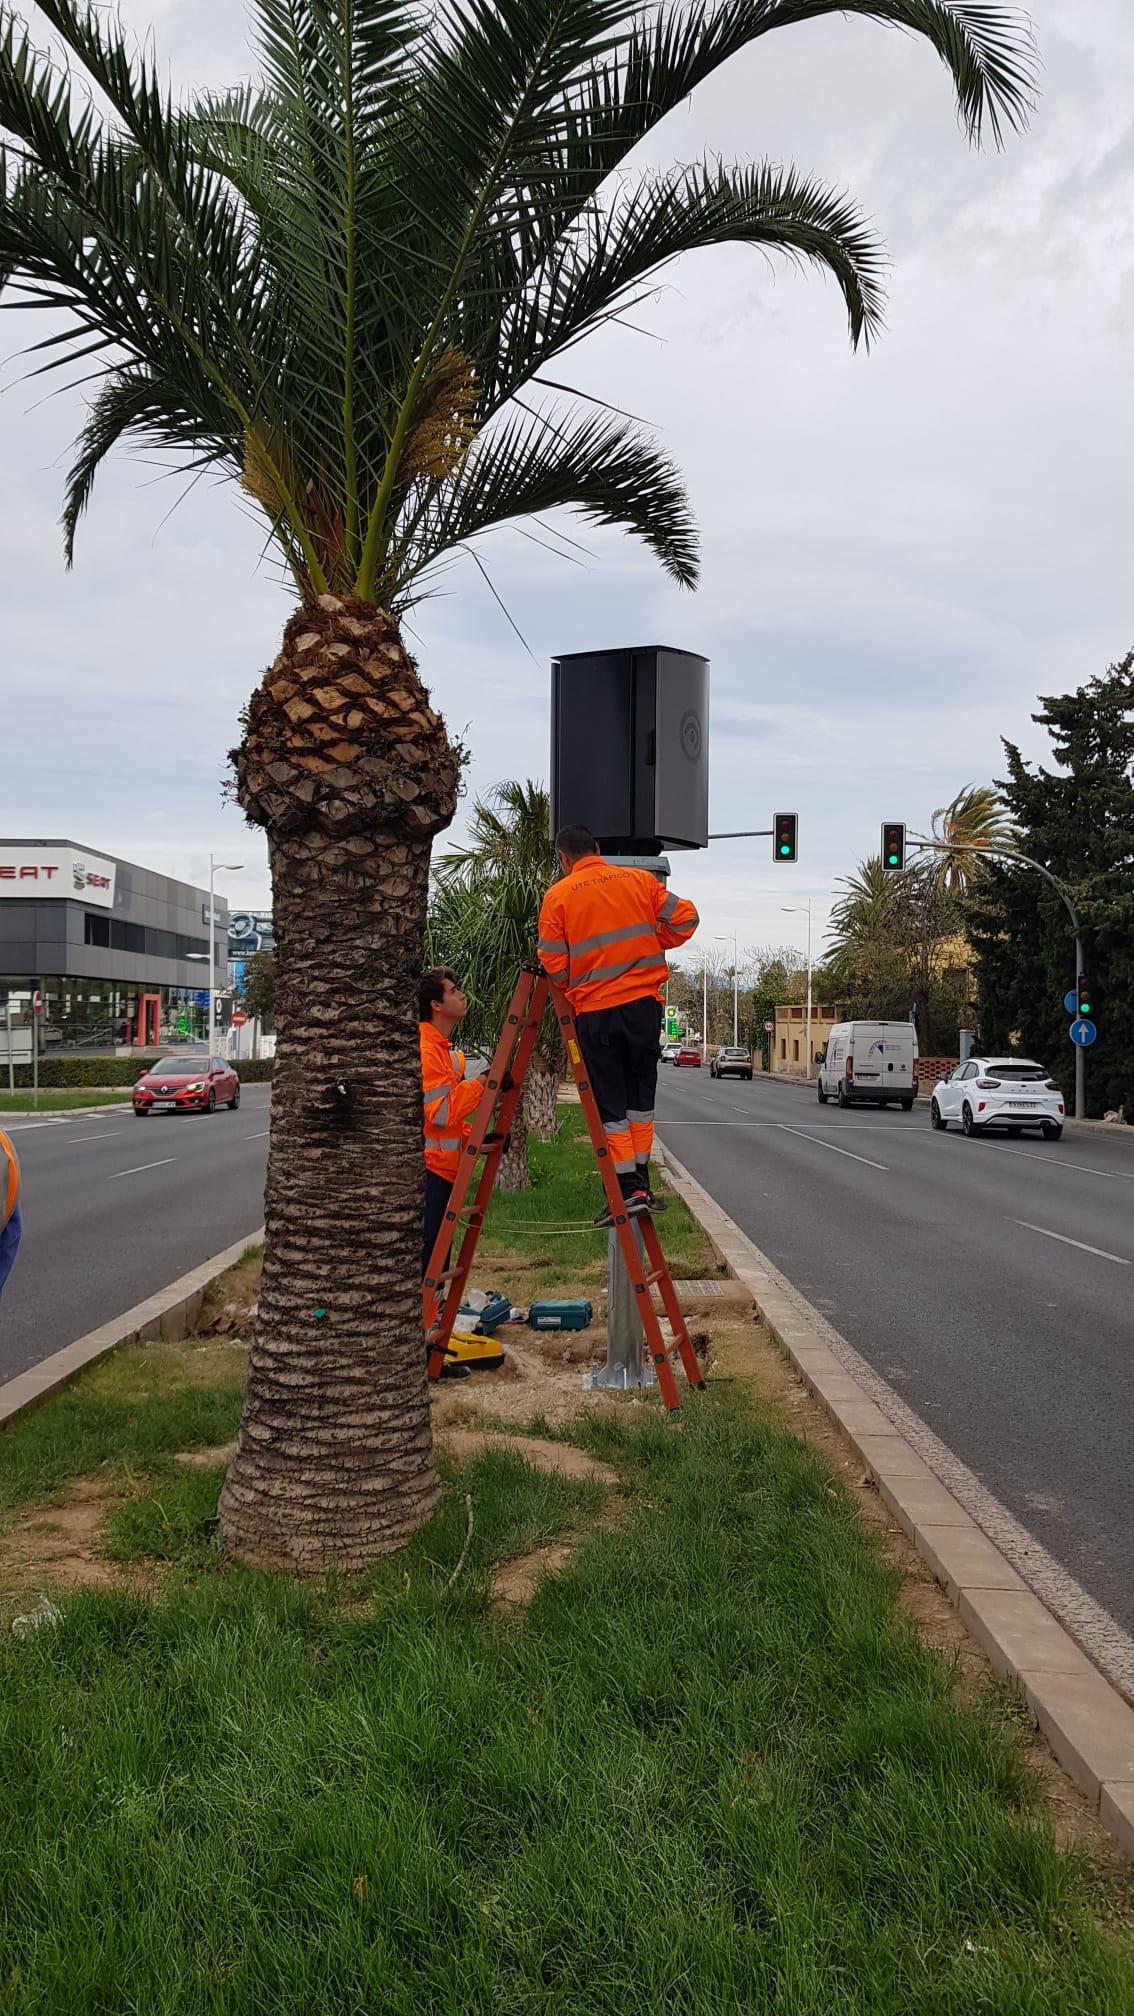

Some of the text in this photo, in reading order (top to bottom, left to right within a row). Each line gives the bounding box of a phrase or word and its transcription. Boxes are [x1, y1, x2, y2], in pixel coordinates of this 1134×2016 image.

[0, 866, 59, 879] EAT
[86, 872, 111, 889] SEAT
[571, 881, 590, 891] UTE
